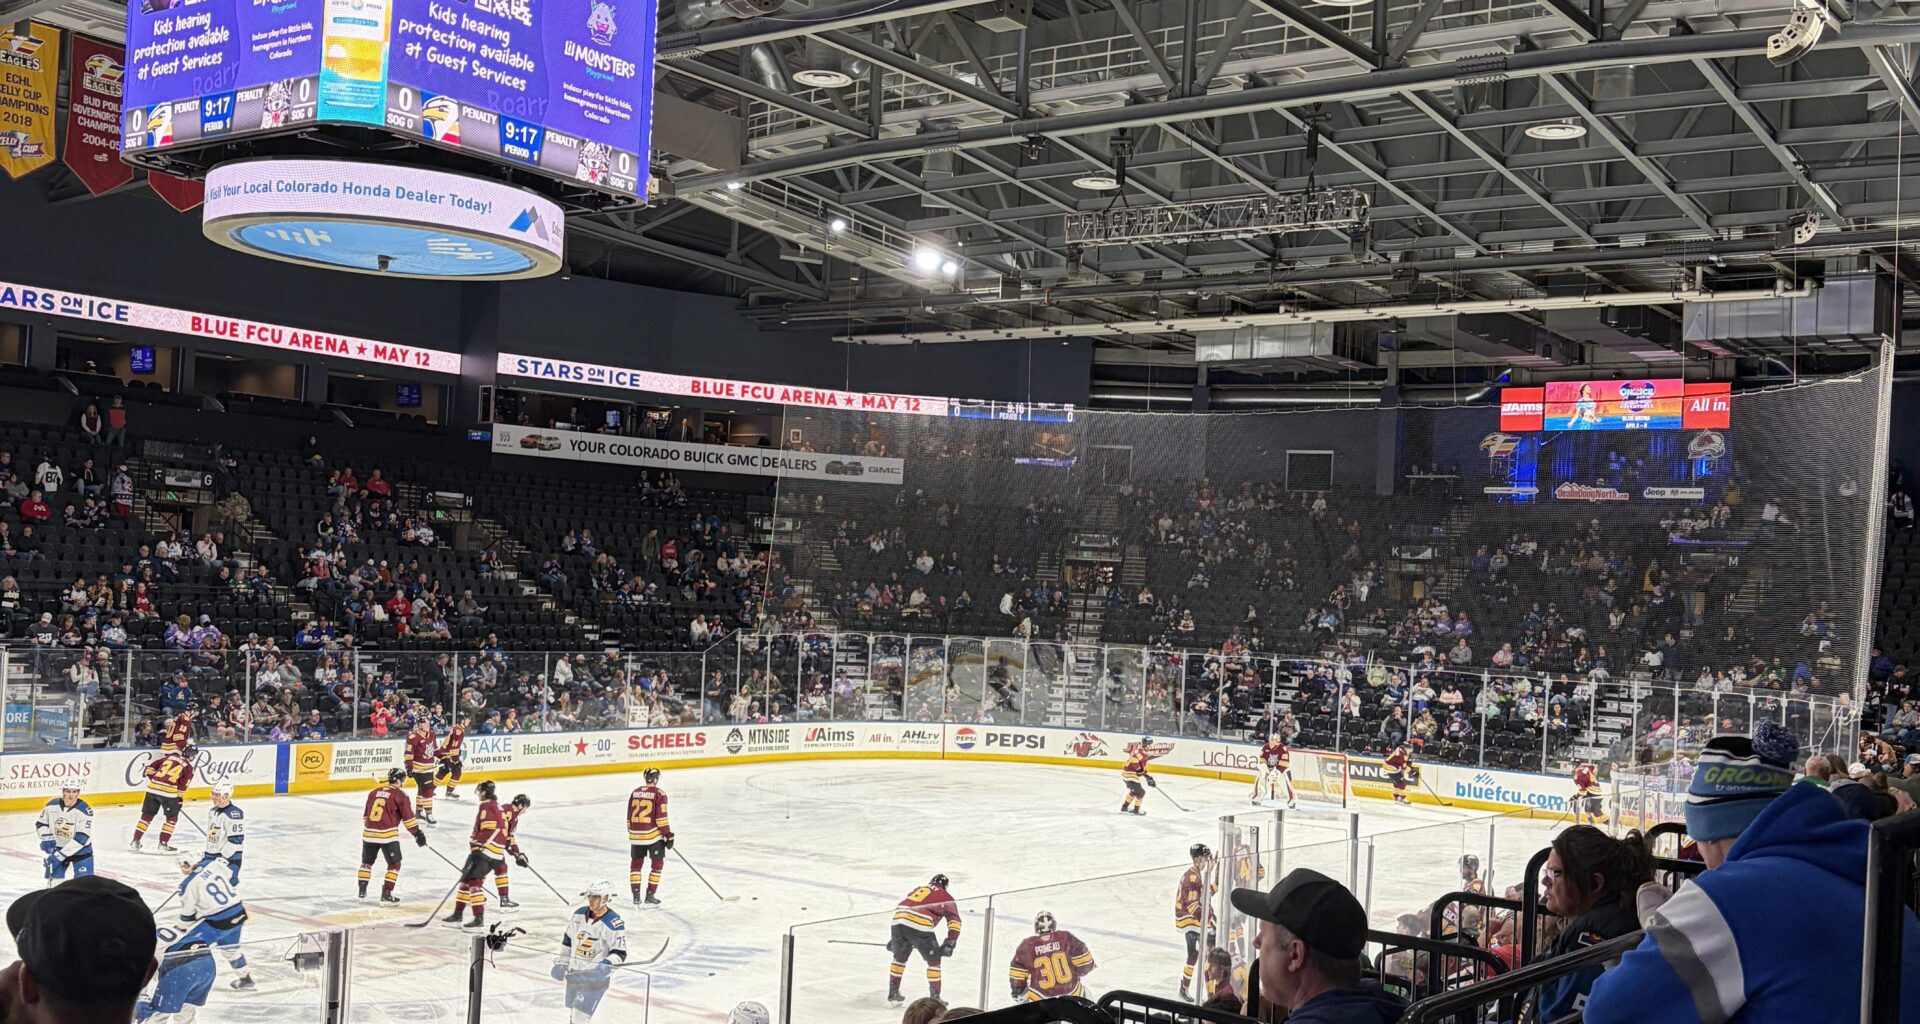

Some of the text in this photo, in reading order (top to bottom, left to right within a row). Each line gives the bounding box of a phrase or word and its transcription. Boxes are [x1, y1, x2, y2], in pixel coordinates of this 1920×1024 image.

[153, 12, 211, 36] Kids hearing
[429, 2, 510, 47] Kids hearing
[134, 25, 230, 64] protection available
[399, 19, 535, 73] protection available
[0, 50, 40, 71] EAGLES
[269, 49, 292, 60] Colorado
[138, 52, 223, 80] at Guest Services
[405, 42, 527, 92] at Guest Services
[6, 72, 31, 87] ECHL
[84, 74, 122, 95] EAGLES
[23, 90, 42, 101] CUP
[236, 88, 263, 103] PENALTY
[300, 78, 309, 102] 0
[563, 81, 582, 94] Indoor
[583, 88, 596, 99] play
[596, 92, 604, 101] for
[605, 95, 619, 106] little
[83, 95, 100, 107] BUD
[174, 100, 200, 113] PENALTY
[205, 97, 231, 117] 9:17
[399, 88, 412, 111] 0
[564, 92, 598, 109] homegrown
[605, 106, 631, 120] Northern
[4, 112, 32, 127] 2018
[73, 104, 118, 122] GOVERNORS'
[133, 110, 141, 131] 0
[291, 107, 313, 121] SOG 0
[462, 106, 498, 125] PENALTY
[584, 110, 610, 124] Colorado
[204, 120, 223, 132] PERIOD
[387, 113, 414, 129] SOG 0
[505, 122, 538, 145] 9:17
[546, 131, 578, 149] PENALTY
[22, 144, 38, 153] CUP
[82, 133, 120, 150] 2004-05
[125, 138, 137, 148] SOG
[504, 144, 538, 161] PERIOD 1
[618, 152, 630, 174] 0
[610, 176, 633, 191] SOG 0
[210, 186, 222, 200] Visit
[223, 184, 241, 197] Your
[244, 180, 272, 194] Local
[276, 180, 338, 193] Colorado
[342, 182, 391, 198] Honda
[395, 186, 445, 204] Dealer
[449, 193, 492, 215] Today!
[0, 287, 129, 322] ARS ON ICE
[191, 316, 430, 366] BLUE FCU ARENA MAY 12
[517, 359, 640, 387] STARS ON ICE
[691, 380, 920, 411] BLUE FCU ARENA MAY 12
[1511, 403, 1543, 412] Aims
[1690, 398, 1730, 411] All in.
[1067, 412, 1073, 422] 0
[570, 439, 817, 471] YOUR COLORADO BUICK GMC DEALERS
[45, 472, 59, 483] 87
[868, 466, 900, 475] GMC
[204, 475, 212, 486] G
[1645, 488, 1666, 496] Jeep
[466, 496, 473, 506] H
[754, 518, 761, 527] H
[1112, 536, 1119, 546] K
[1392, 547, 1399, 556] K
[1680, 554, 1739, 566] L M
[5, 712, 29, 723] ORE
[628, 732, 706, 750] SCHEELS
[748, 729, 790, 745] MTNSIDE
[817, 727, 855, 742] Aims
[869, 734, 894, 743] All in.
[985, 733, 1045, 749] PEPSI
[337, 749, 364, 757] BUILDING
[376, 747, 392, 755] STAGE
[470, 738, 512, 753] TAKE
[523, 743, 570, 756] Heineken
[193, 748, 254, 785] Royal
[305, 755, 321, 764] PCL
[335, 757, 346, 765] FOR
[371, 755, 392, 763] MAKING
[492, 755, 512, 763] KEYS
[10, 761, 91, 780] SEASONS
[156, 759, 184, 784] 34
[334, 765, 362, 774] MOMENTS
[1456, 782, 1565, 811] bluefcu.com
[370, 798, 386, 822] 6
[631, 799, 653, 823] 22
[85, 820, 91, 829] 5
[232, 824, 243, 832] 85
[1035, 941, 1060, 955] PRIMEAU
[1034, 951, 1072, 990] 30
